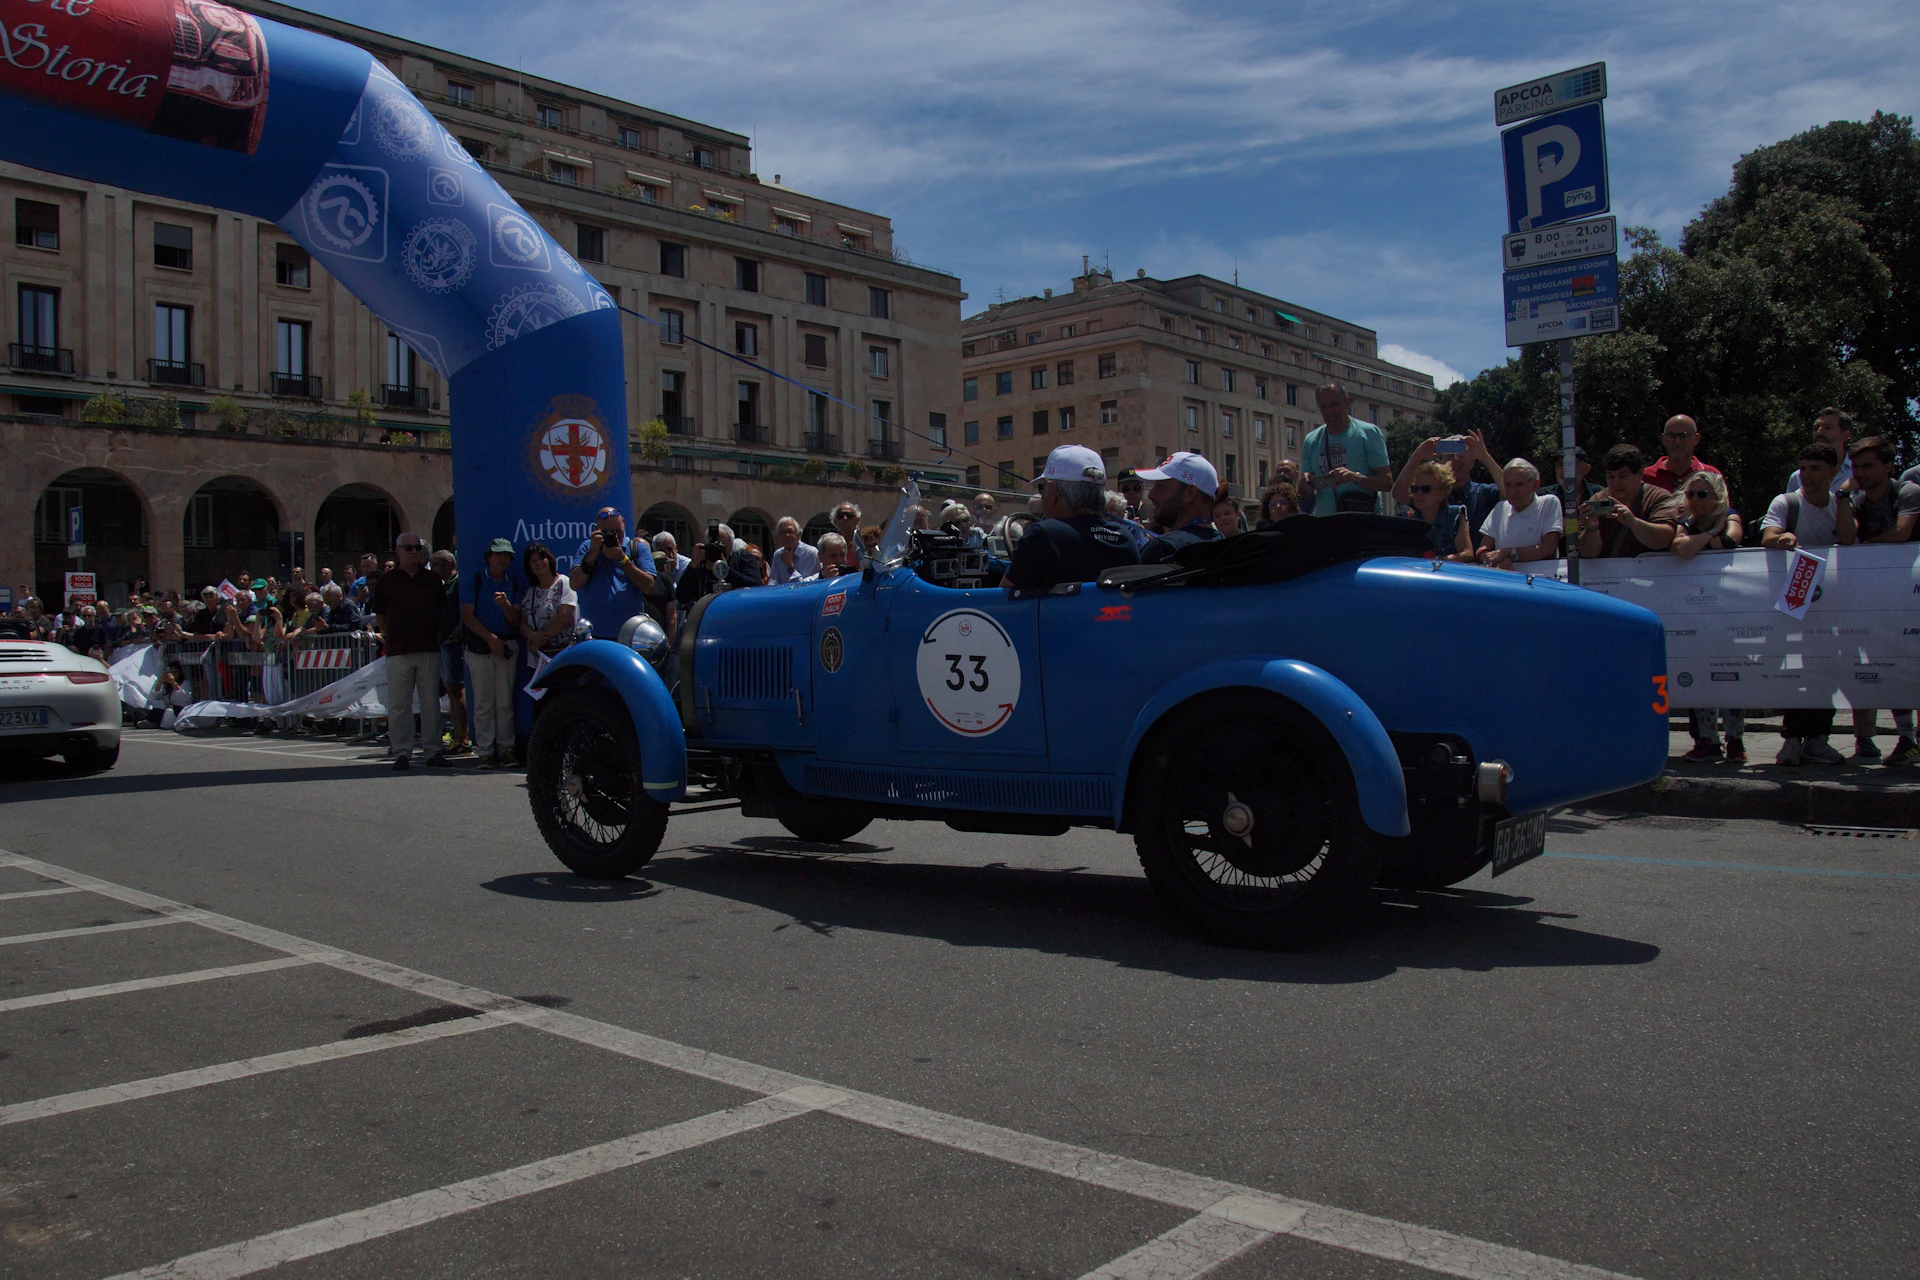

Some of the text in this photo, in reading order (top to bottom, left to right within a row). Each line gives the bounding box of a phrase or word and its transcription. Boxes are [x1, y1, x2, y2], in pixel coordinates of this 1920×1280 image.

[0, 20, 159, 98] Storia
[1499, 95, 1555, 118] PARKING
[1500, 83, 1553, 107] APCOA
[1521, 124, 1582, 217] P
[1535, 233, 1560, 244] 8.00
[1576, 224, 1608, 237] 21.00
[1537, 251, 1557, 260] tariffa
[1506, 259, 1610, 282] PREGASI PRENDERE VISIONE
[1517, 285, 1532, 293] DEL
[1596, 285, 1607, 293] SU
[1566, 297, 1614, 310] ARCOMETRO
[1537, 320, 1564, 330] APCOA
[1181, 471, 1195, 481] 33
[71, 511, 80, 542] P
[1787, 557, 1808, 598] MIGLIA
[1797, 563, 1816, 599] 1000
[945, 654, 989, 693] 33
